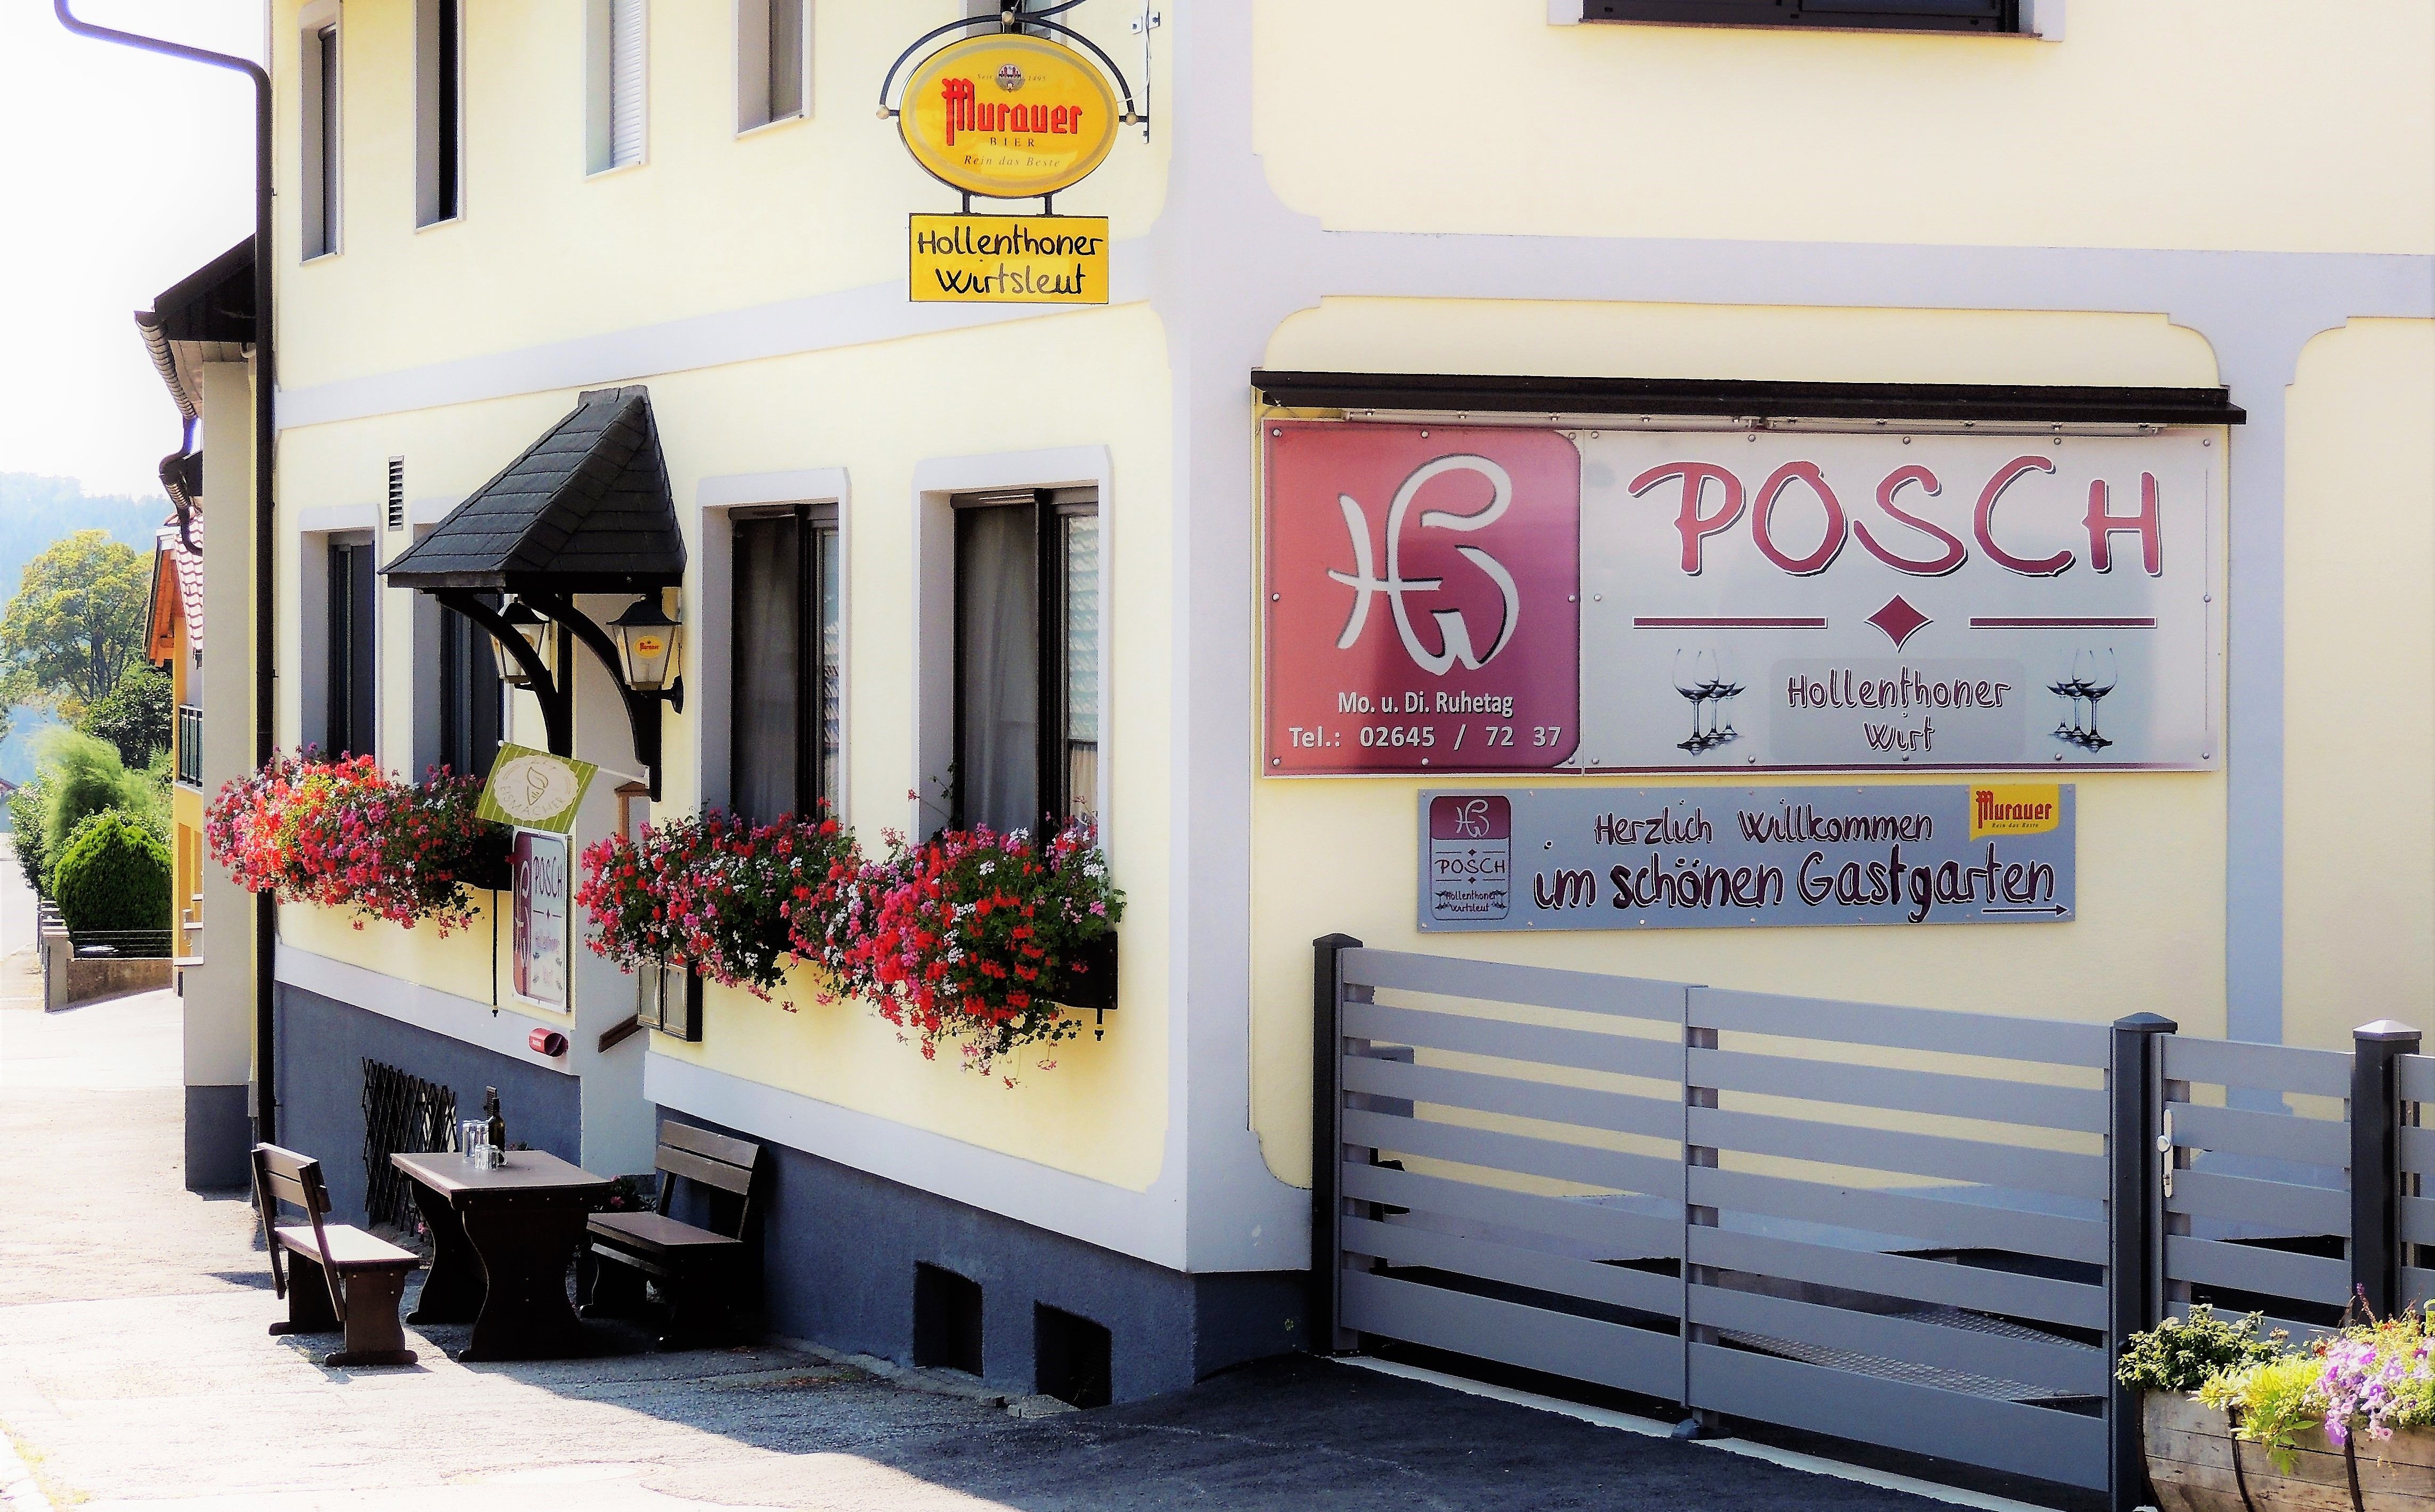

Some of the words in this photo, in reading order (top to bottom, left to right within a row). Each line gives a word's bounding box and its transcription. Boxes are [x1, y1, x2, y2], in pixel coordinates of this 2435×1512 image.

[941, 78, 1082, 146] Murauer
[964, 155, 993, 166] Rein
[999, 156, 1020, 167] das
[1027, 157, 1061, 167] Beste
[990, 137, 1035, 148] BIER
[917, 223, 1103, 256] Hollenthoner
[935, 259, 1086, 295] Wirtsleut
[1627, 455, 2163, 577] POSCH
[1338, 691, 1375, 714] Mo.
[1381, 697, 1398, 714] u.
[1405, 691, 1430, 714] Di.
[1437, 691, 1514, 717] Ruhetag
[1786, 666, 2012, 709] Hollenthoner
[1289, 726, 1341, 748] Tel.:
[1359, 726, 1436, 748] 02645
[1454, 724, 1467, 751] /
[1485, 726, 1514, 747] 72
[1533, 726, 1562, 747] 37
[1863, 711, 1934, 753] Wirt
[500, 785, 567, 816] EISMACHER
[1975, 790, 2053, 829] Murauer
[1594, 799, 1714, 845] Herzlich
[1737, 797, 1934, 844] Willkommen
[532, 855, 563, 899] POSCH
[1434, 857, 1505, 874] POSCH
[1533, 840, 1598, 911] im
[1609, 852, 1785, 910] schönen
[1796, 842, 2056, 924] Gastgarten
